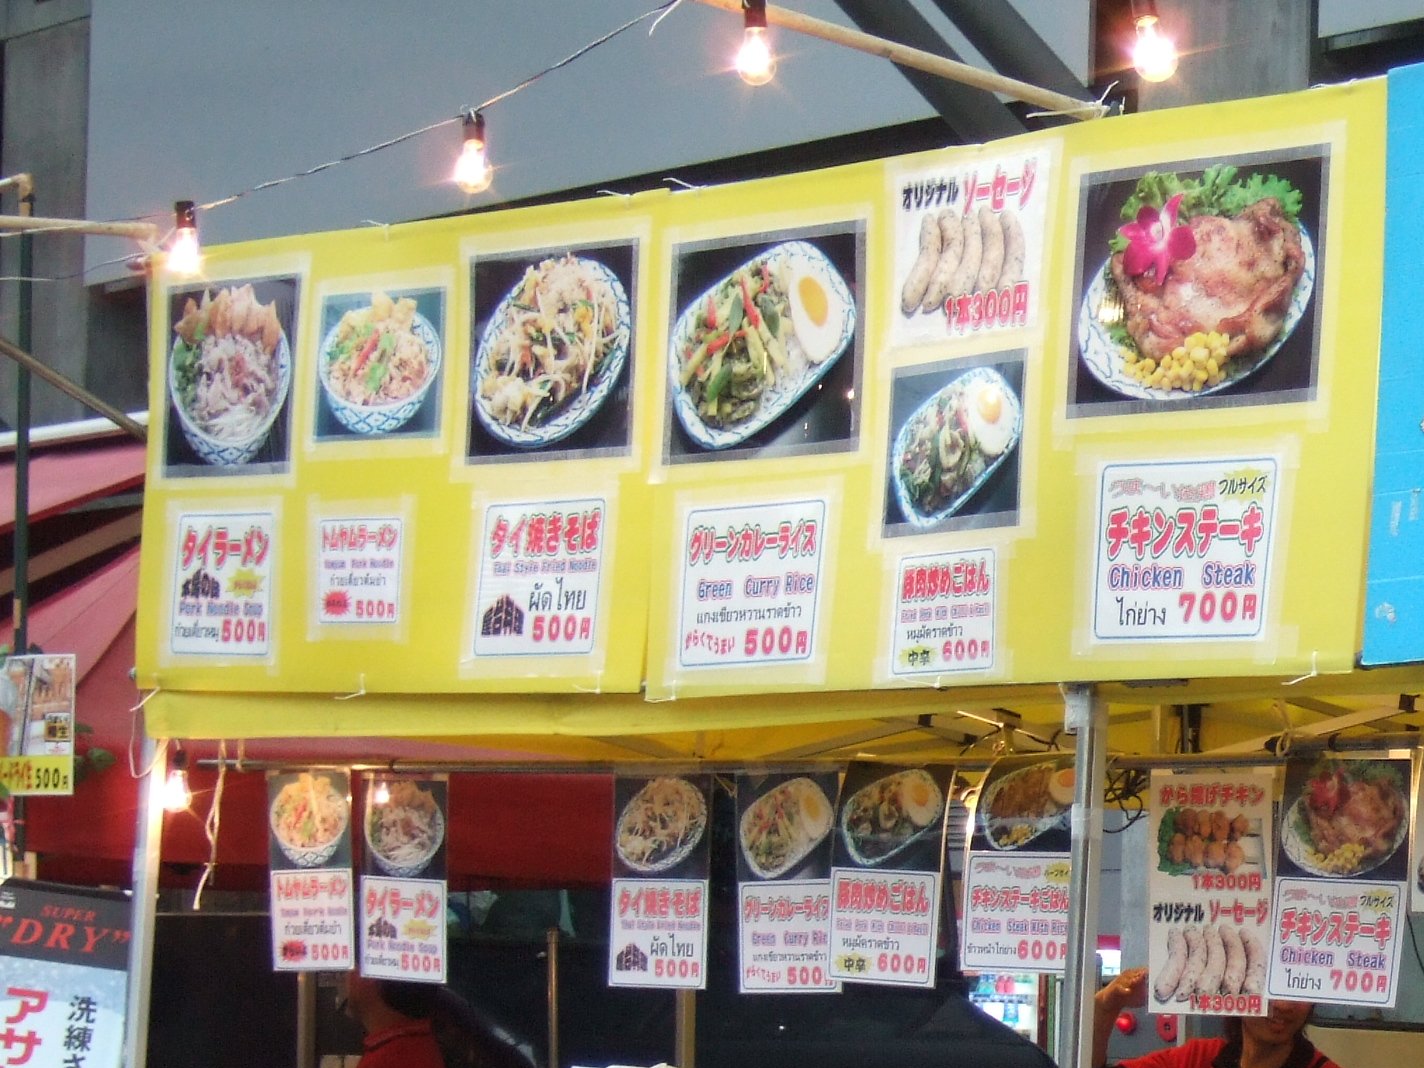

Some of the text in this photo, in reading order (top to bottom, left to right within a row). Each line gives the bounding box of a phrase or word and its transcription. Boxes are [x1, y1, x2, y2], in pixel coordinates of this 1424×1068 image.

[902, 158, 1038, 217] オリジナル ソーセージ
[944, 281, 1029, 335] 1本300円
[1218, 475, 1268, 496] フルサイズ
[322, 524, 399, 551] トムヤムラーメン
[490, 508, 601, 557] タイ焼きそば
[689, 518, 817, 567] グリーンカレーライス
[1106, 501, 1264, 561] チキンステーキ
[181, 525, 271, 570] タイラーメン
[697, 572, 815, 600] Green Curry Rice
[1109, 560, 1257, 590] Chicken Steak
[355, 600, 395, 618] 500円
[1178, 590, 1258, 624] 700円
[221, 618, 266, 643] 500円
[532, 615, 591, 643] 500円
[744, 626, 808, 656] 500円
[35, 768, 69, 789] 500円
[1159, 782, 1265, 808] から揚げチキン
[1191, 873, 1263, 892] 1本300円
[42, 904, 96, 923] SUPER
[367, 886, 440, 919] タイラーメン
[618, 887, 702, 919] タイ焼きそば
[1153, 901, 1205, 925] オリジナル
[1209, 898, 1269, 926] ソーセージ
[1279, 907, 1393, 951] チキンステーキ
[654, 959, 700, 978] 500円
[877, 953, 927, 974] 600円
[1280, 946, 1387, 970] Chicken Steak
[1328, 970, 1388, 994] 700円
[1188, 993, 1263, 1014] 1本300円
